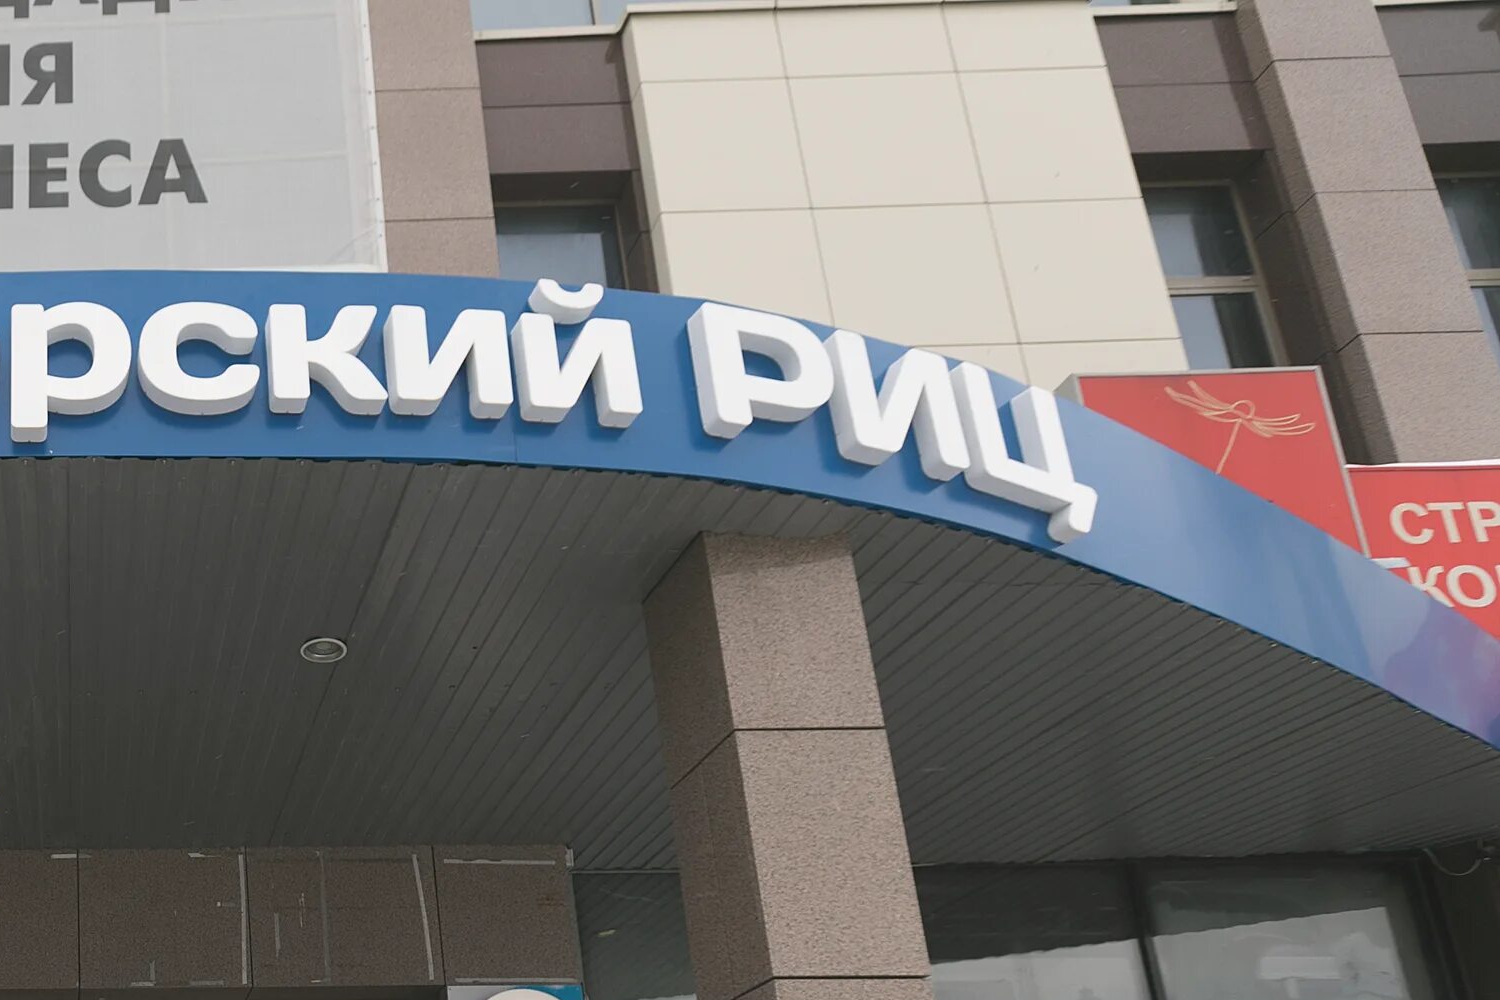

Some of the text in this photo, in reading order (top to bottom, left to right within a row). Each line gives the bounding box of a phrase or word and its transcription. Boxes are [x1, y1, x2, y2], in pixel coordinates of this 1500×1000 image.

[686, 301, 1098, 544] РИЦ
[1389, 501, 1500, 544] СТР
[1406, 564, 1500, 608] КО
